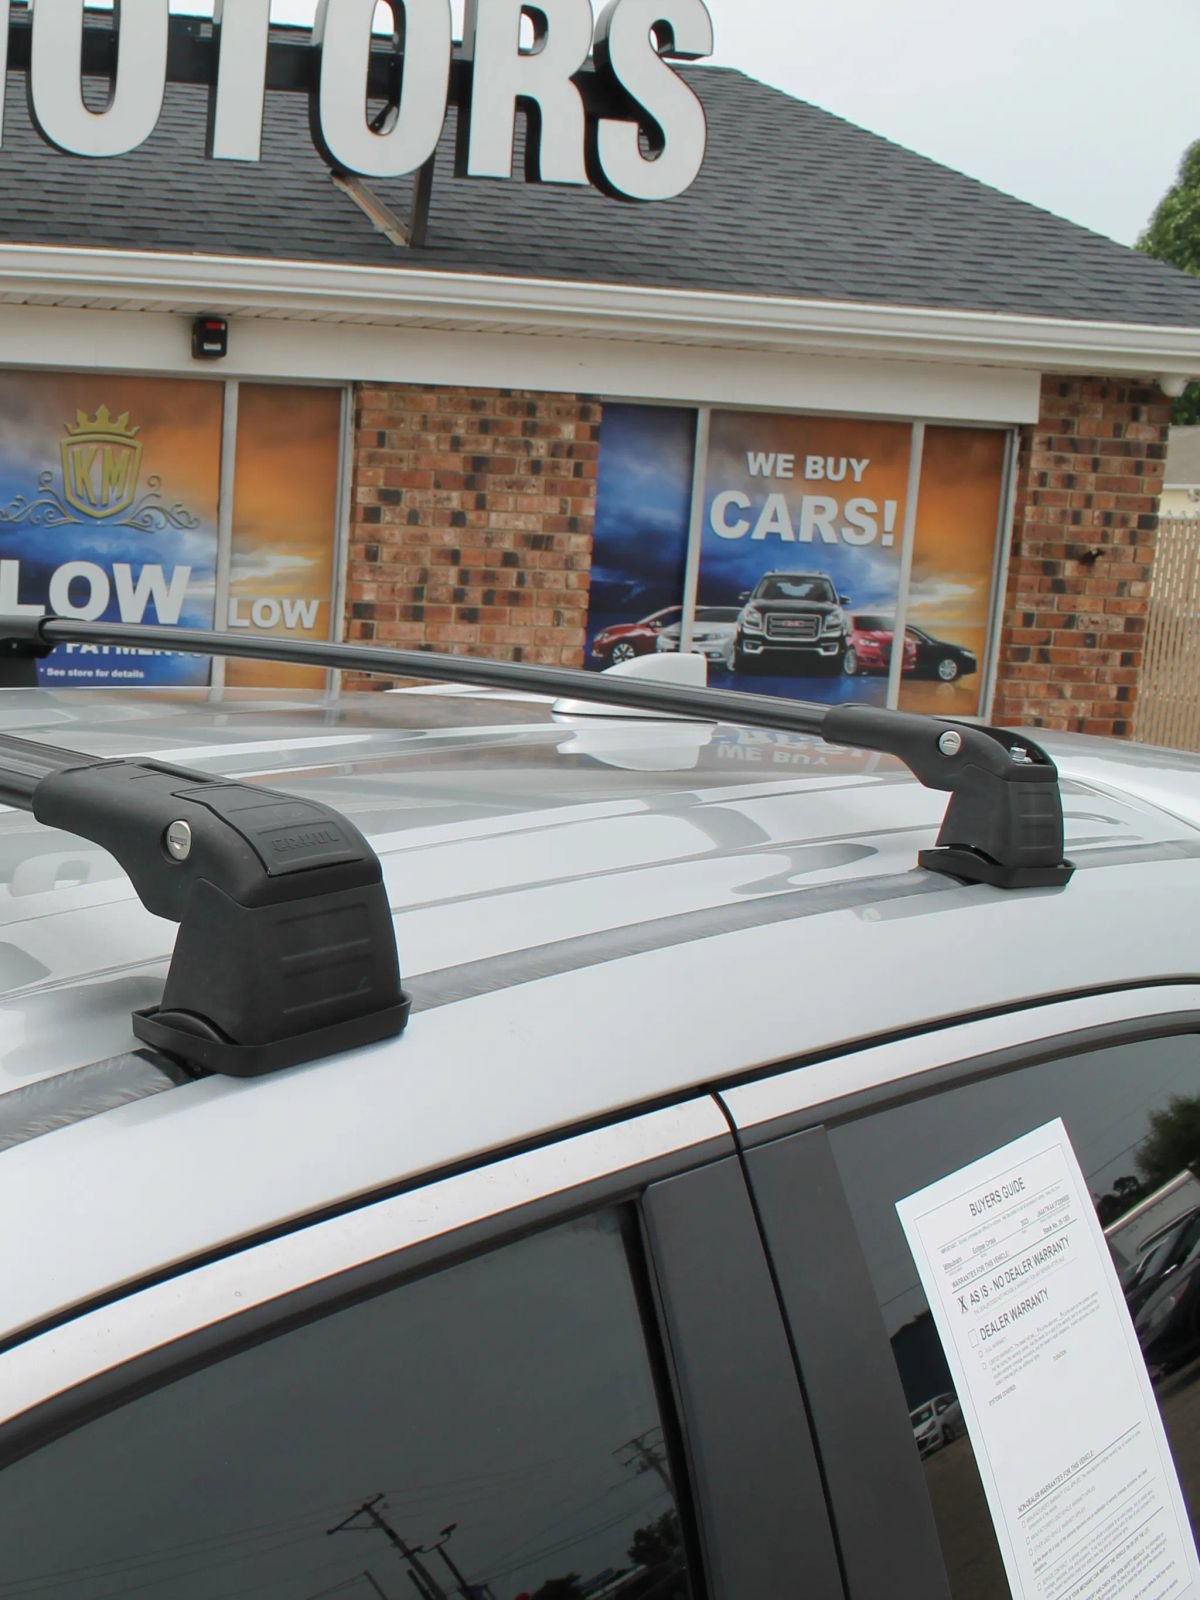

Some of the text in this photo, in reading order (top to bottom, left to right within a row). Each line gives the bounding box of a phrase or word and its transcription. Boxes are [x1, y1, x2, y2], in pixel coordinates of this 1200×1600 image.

[72, 446, 132, 505] KM
[746, 451, 870, 482] WE BUY
[710, 490, 898, 546] CARS!
[228, 598, 319, 629] LOW
[47, 667, 145, 678] See store for details
[969, 1177, 1026, 1216] BUYERS GUIDE
[957, 1295, 969, 1315] X
[969, 1290, 980, 1306] AS
[980, 1284, 989, 1299] IS
[992, 1276, 1005, 1292] NO
[1005, 1258, 1033, 1284] DEALER
[1032, 1235, 1070, 1266] WARRANTY
[979, 1287, 1050, 1341] DEALER WARRANTY
